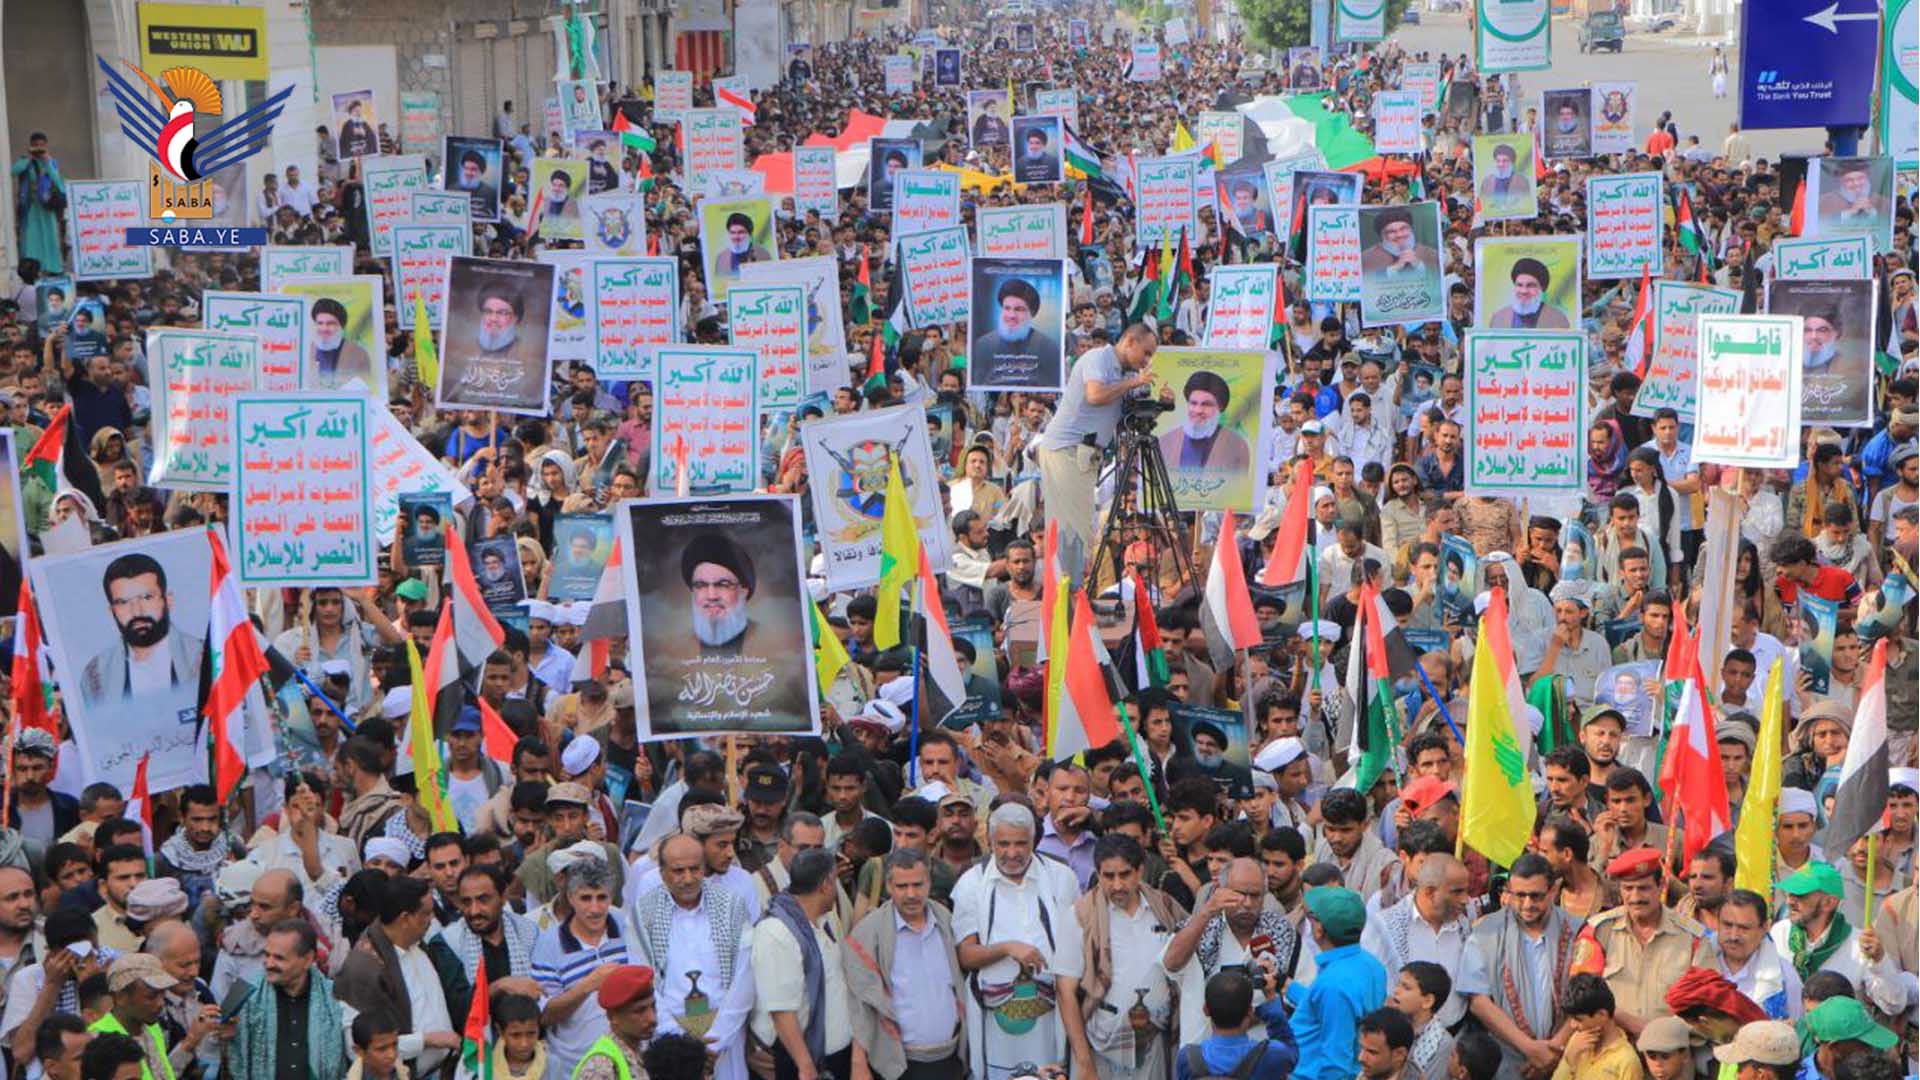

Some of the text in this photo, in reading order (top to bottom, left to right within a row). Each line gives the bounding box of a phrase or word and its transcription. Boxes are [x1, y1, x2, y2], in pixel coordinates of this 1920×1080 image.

[151, 31, 211, 41] WESTERN
[170, 40, 211, 50] UNION
[217, 34, 251, 50] WU
[1757, 92, 1771, 100] The
[1792, 91, 1809, 99] You
[1810, 90, 1832, 99] Trust
[1632, 183, 1656, 198] الله
[1025, 215, 1051, 232] الله
[438, 234, 462, 249] الله
[939, 234, 961, 251] الله
[311, 255, 340, 273] الله
[1784, 247, 1862, 276] الله أكبر
[643, 269, 671, 287] الله
[774, 293, 799, 314] الله
[213, 306, 299, 332] الله أكبر
[771, 320, 799, 337] الموت
[262, 337, 298, 354] الموت
[771, 341, 799, 359] الموت
[1709, 327, 1782, 360] قاطعوا
[219, 345, 250, 368] الله
[601, 350, 637, 368] للإسلام
[1477, 343, 1577, 376] الله أكبر
[262, 360, 298, 377] الموت
[664, 357, 751, 389] الله أكبر
[762, 363, 776, 379] على
[213, 377, 251, 397] الموت
[773, 378, 801, 402] النصر
[1532, 380, 1575, 401] الموت
[1749, 368, 1787, 394] البضائع
[711, 392, 750, 412] الموت
[244, 406, 359, 447] الله أكبر
[711, 416, 750, 435] الموت
[1532, 406, 1575, 427] الموت
[202, 430, 219, 448] على
[1477, 431, 1575, 450] اللعنة على اليهود
[662, 440, 746, 459] اللعنة على اليود
[167, 449, 210, 475] للإسلام
[309, 452, 359, 475] الموت
[662, 459, 752, 485] النصر للإلام
[1477, 453, 1575, 482] النصر للإسلام
[309, 483, 359, 506] الموت
[245, 511, 360, 537] اللعنة على اليهود
[246, 538, 361, 575] النصر للإسلام
